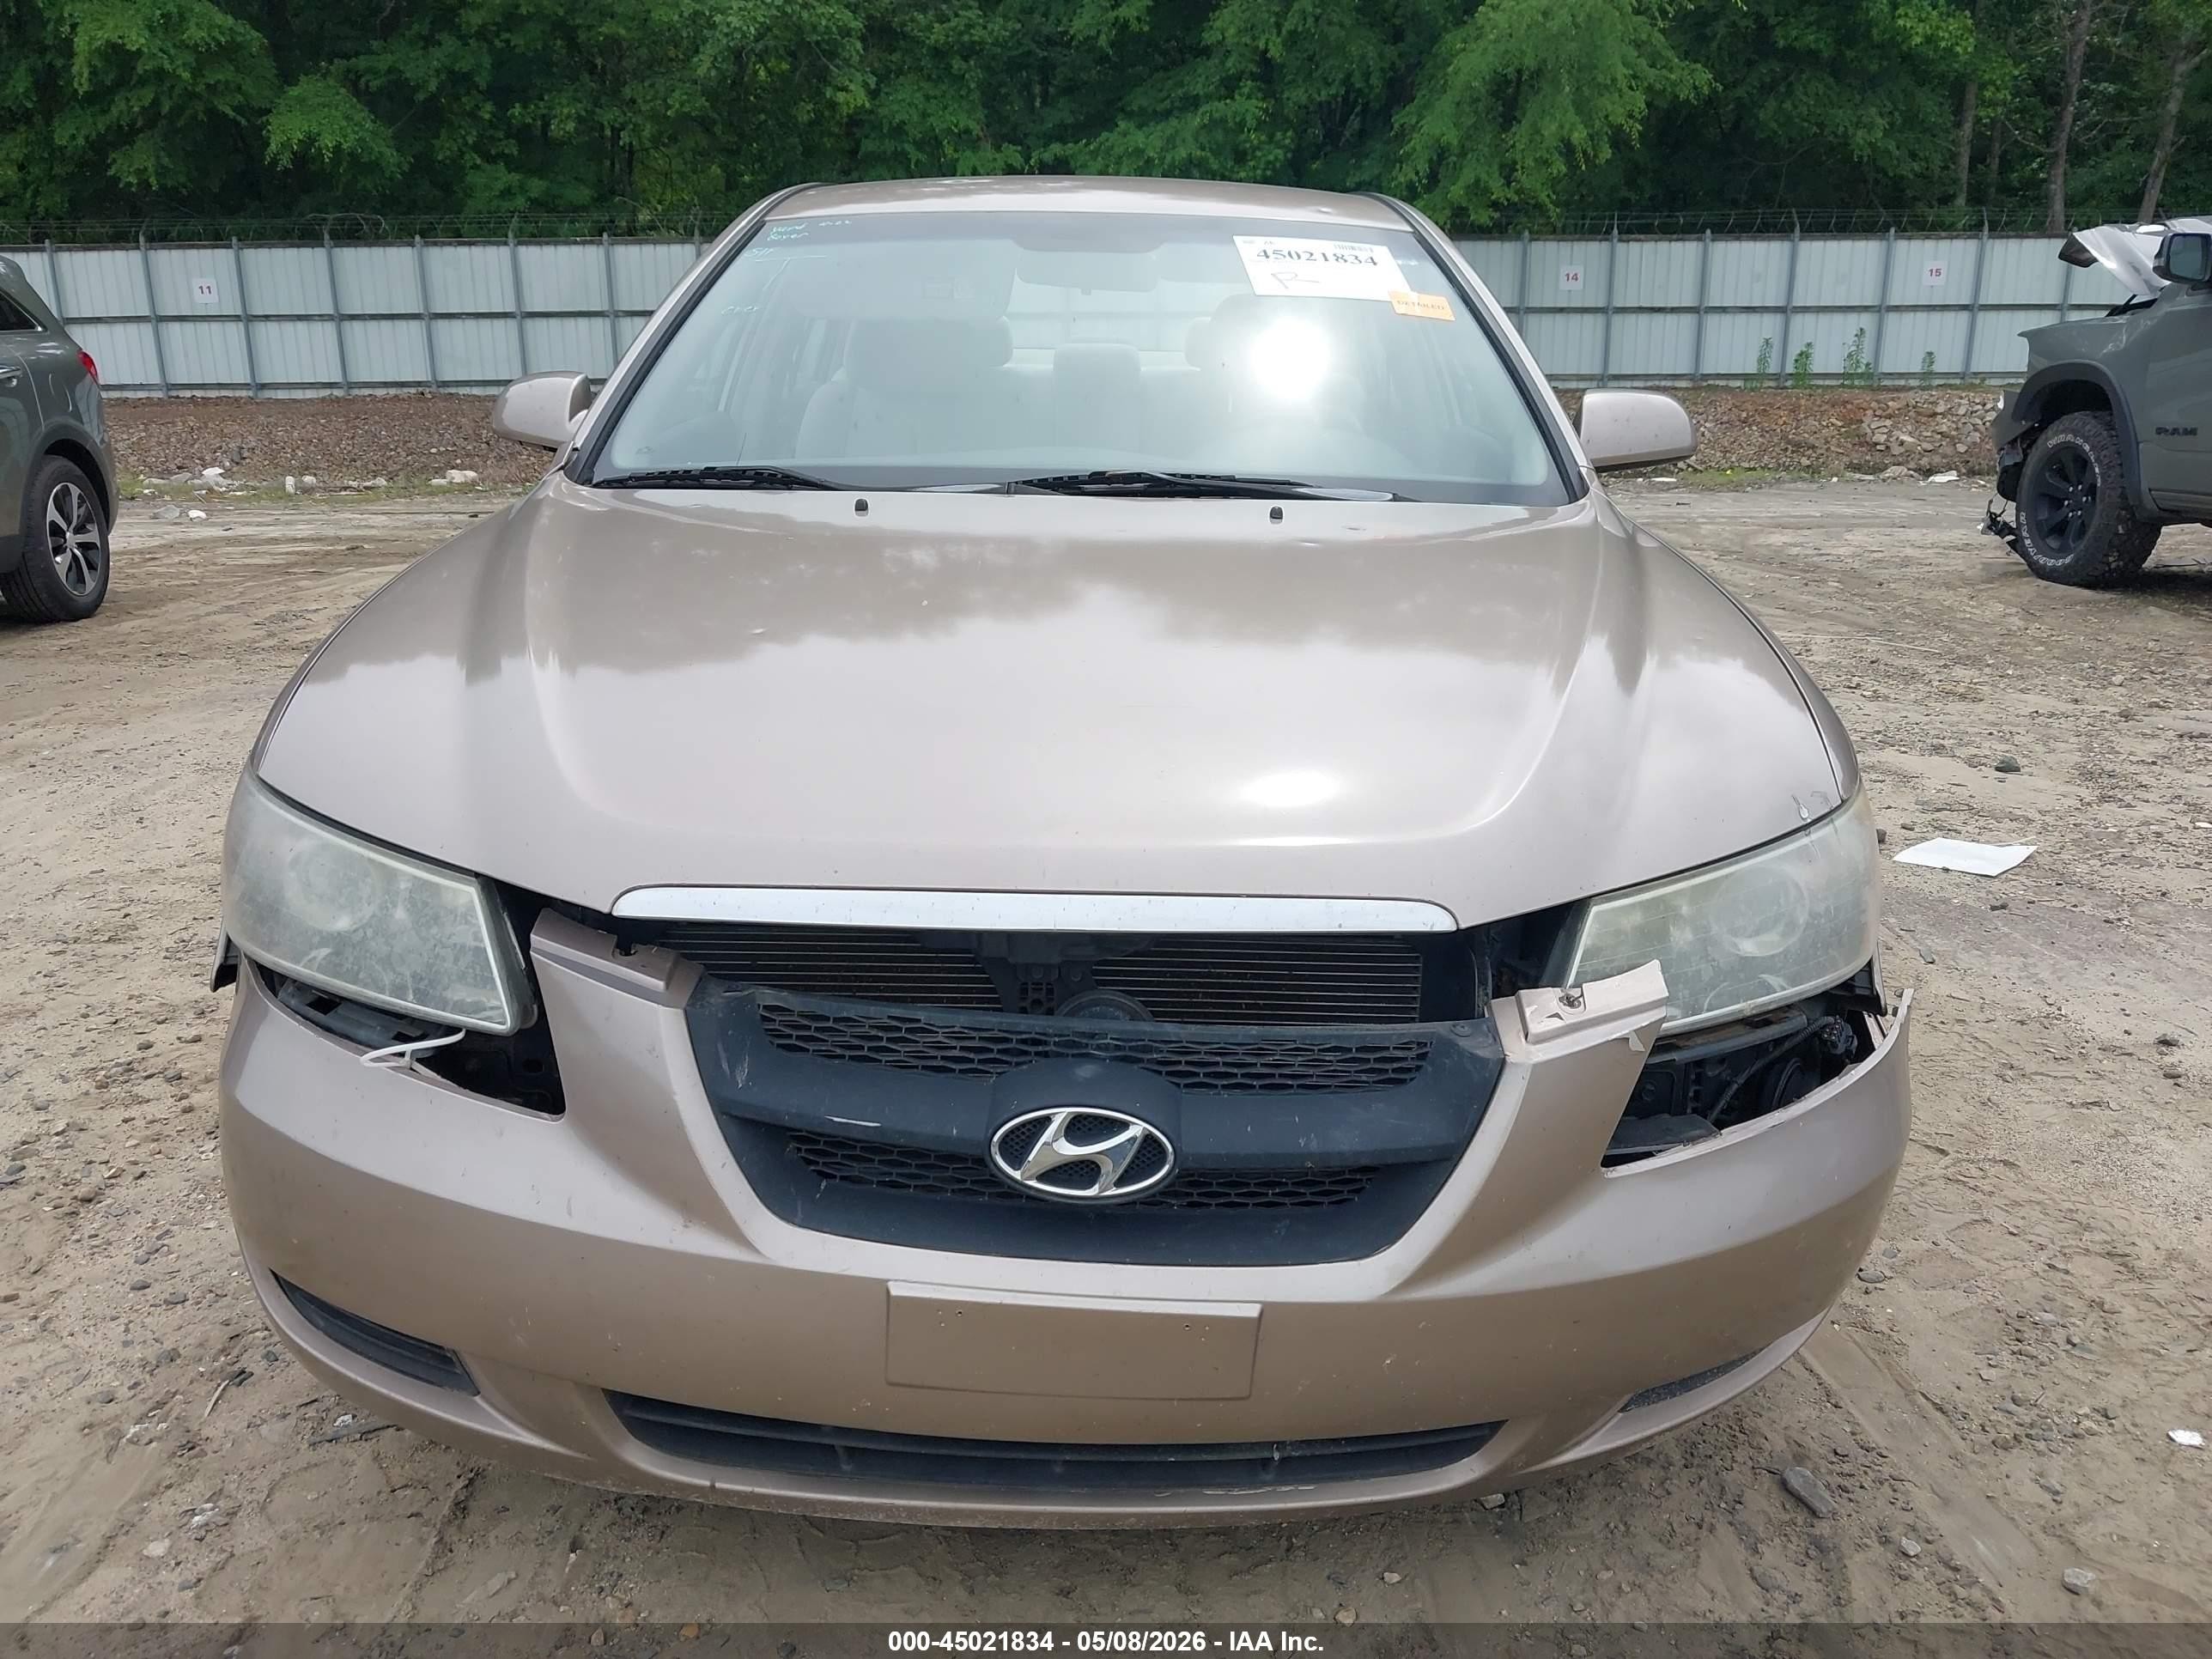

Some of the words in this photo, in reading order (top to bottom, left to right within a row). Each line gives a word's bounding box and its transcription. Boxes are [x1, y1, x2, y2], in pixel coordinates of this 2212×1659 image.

[1256, 249, 1377, 266] 45021834
[1565, 272, 1579, 283] 14
[1929, 268, 1942, 277] 15
[198, 285, 212, 295] 11
[2155, 427, 2198, 436] RAM
